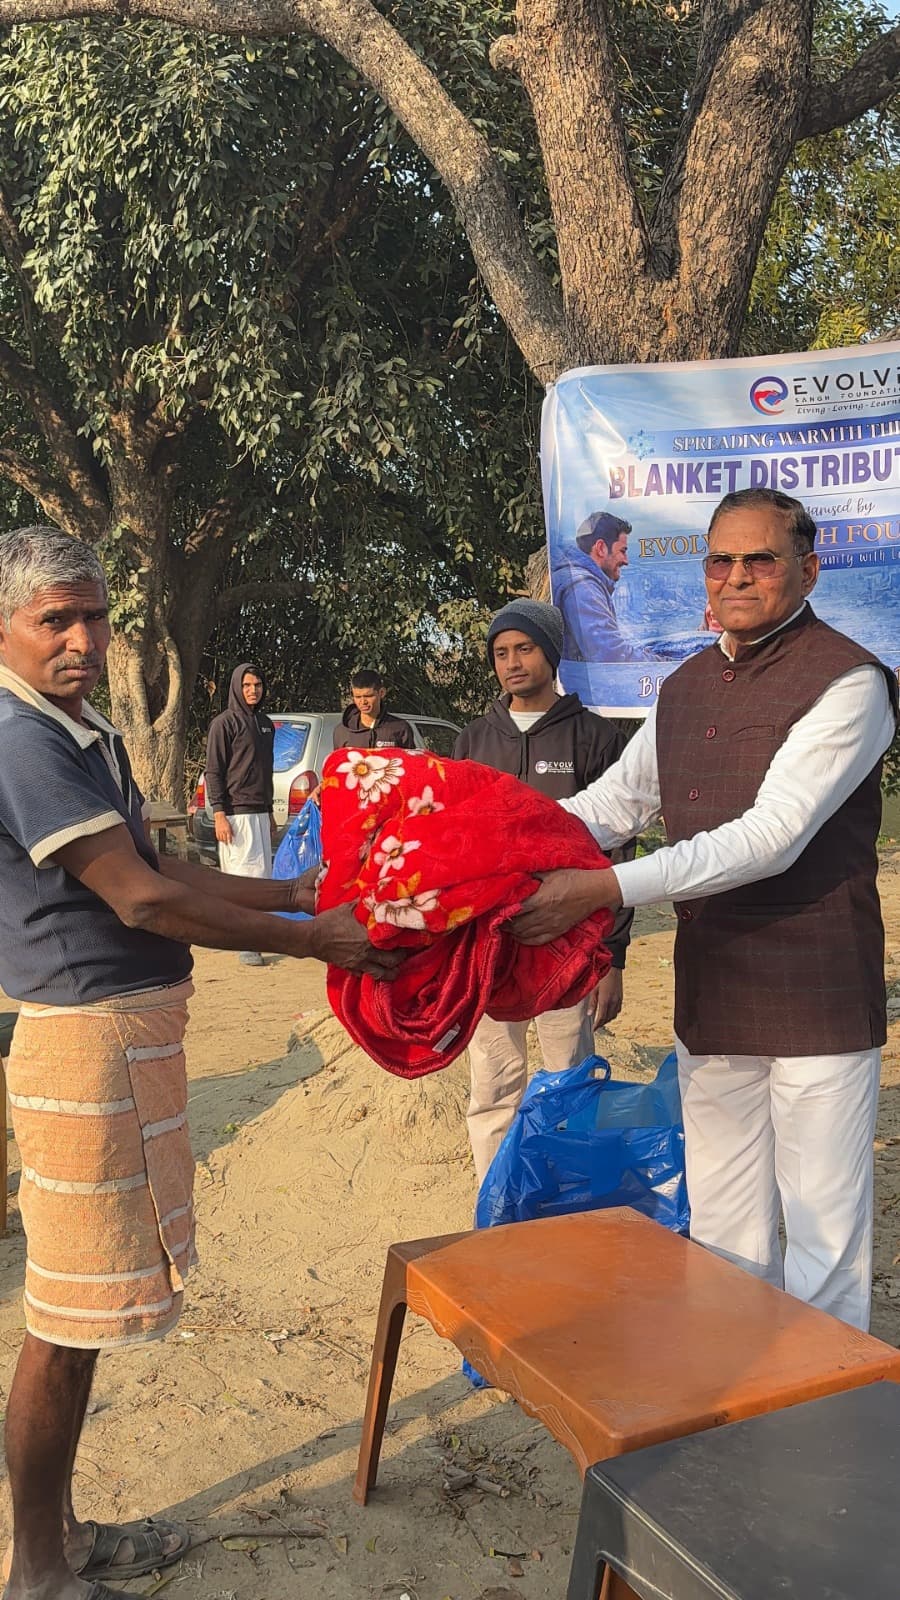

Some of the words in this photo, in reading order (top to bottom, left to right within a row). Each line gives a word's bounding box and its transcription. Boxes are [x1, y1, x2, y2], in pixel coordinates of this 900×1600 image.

[793, 366, 900, 395] EVOLV
[795, 395, 830, 403] SANGH
[840, 387, 900, 399] FOUNDATI
[870, 398, 900, 407] Learn
[673, 432, 775, 451] SPREADING
[778, 426, 862, 446] WARMTH
[609, 461, 742, 499] BLANKET
[857, 498, 876, 515] by
[821, 553, 853, 567] anity
[860, 550, 885, 562] with
